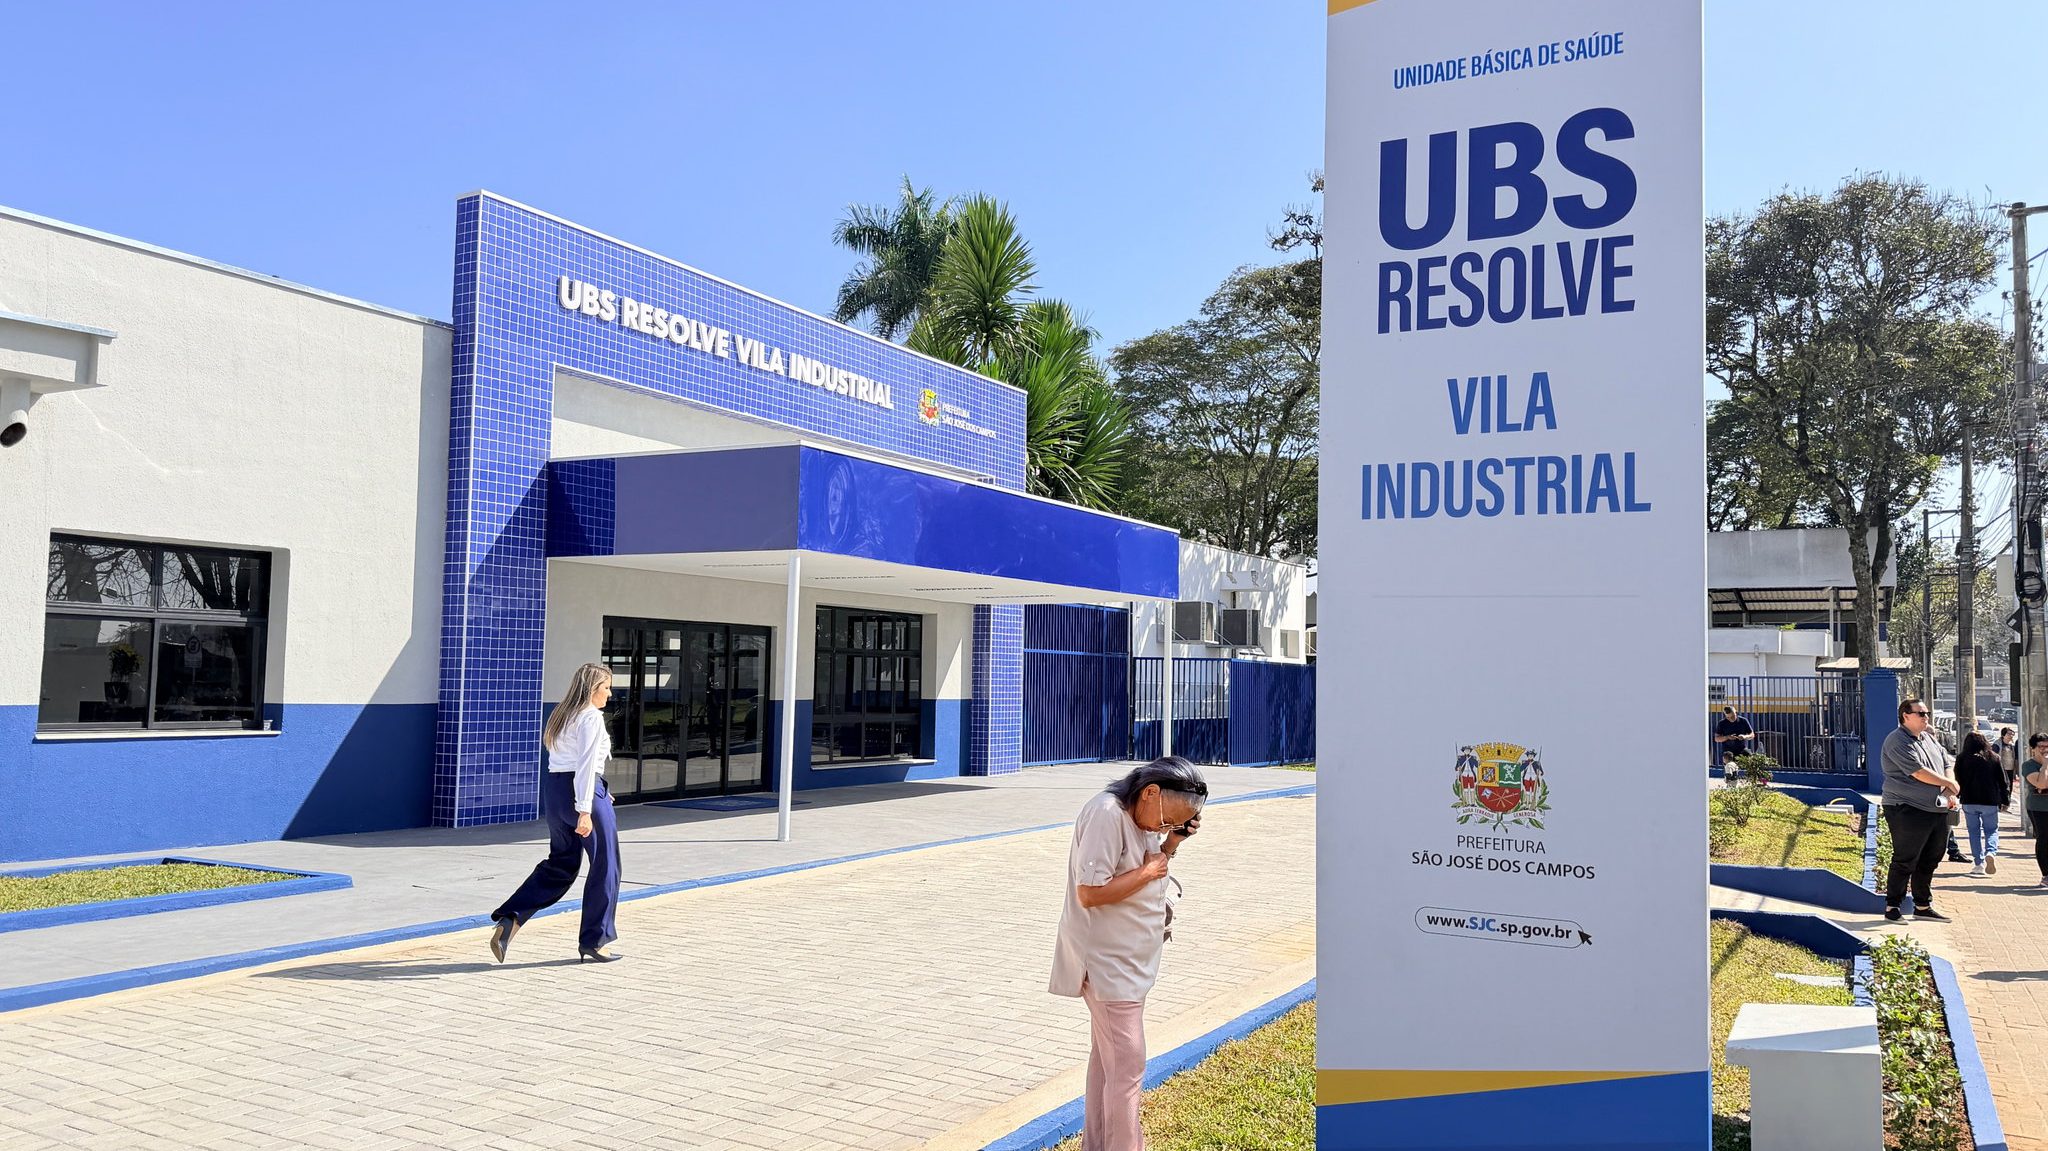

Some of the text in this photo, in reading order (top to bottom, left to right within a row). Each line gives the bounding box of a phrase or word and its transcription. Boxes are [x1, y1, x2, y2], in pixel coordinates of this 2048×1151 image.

[1393, 31, 1624, 90] UNIDADE BÁSICA DE SAÚDE
[1378, 107, 1638, 251] UBS
[1377, 234, 1636, 335] RESOLVE
[558, 275, 895, 410] UBS RESOLVE VILA INDUSTRIAL
[1447, 371, 1558, 436] VILA
[1361, 451, 1652, 520] INDUSTRIAL
[1411, 850, 1596, 880] SÃO JOSÉ DOS CAMPOS
[1457, 834, 1546, 856] PREFEITURA
[1426, 914, 1573, 939] www.SJC.sp.gov.br
